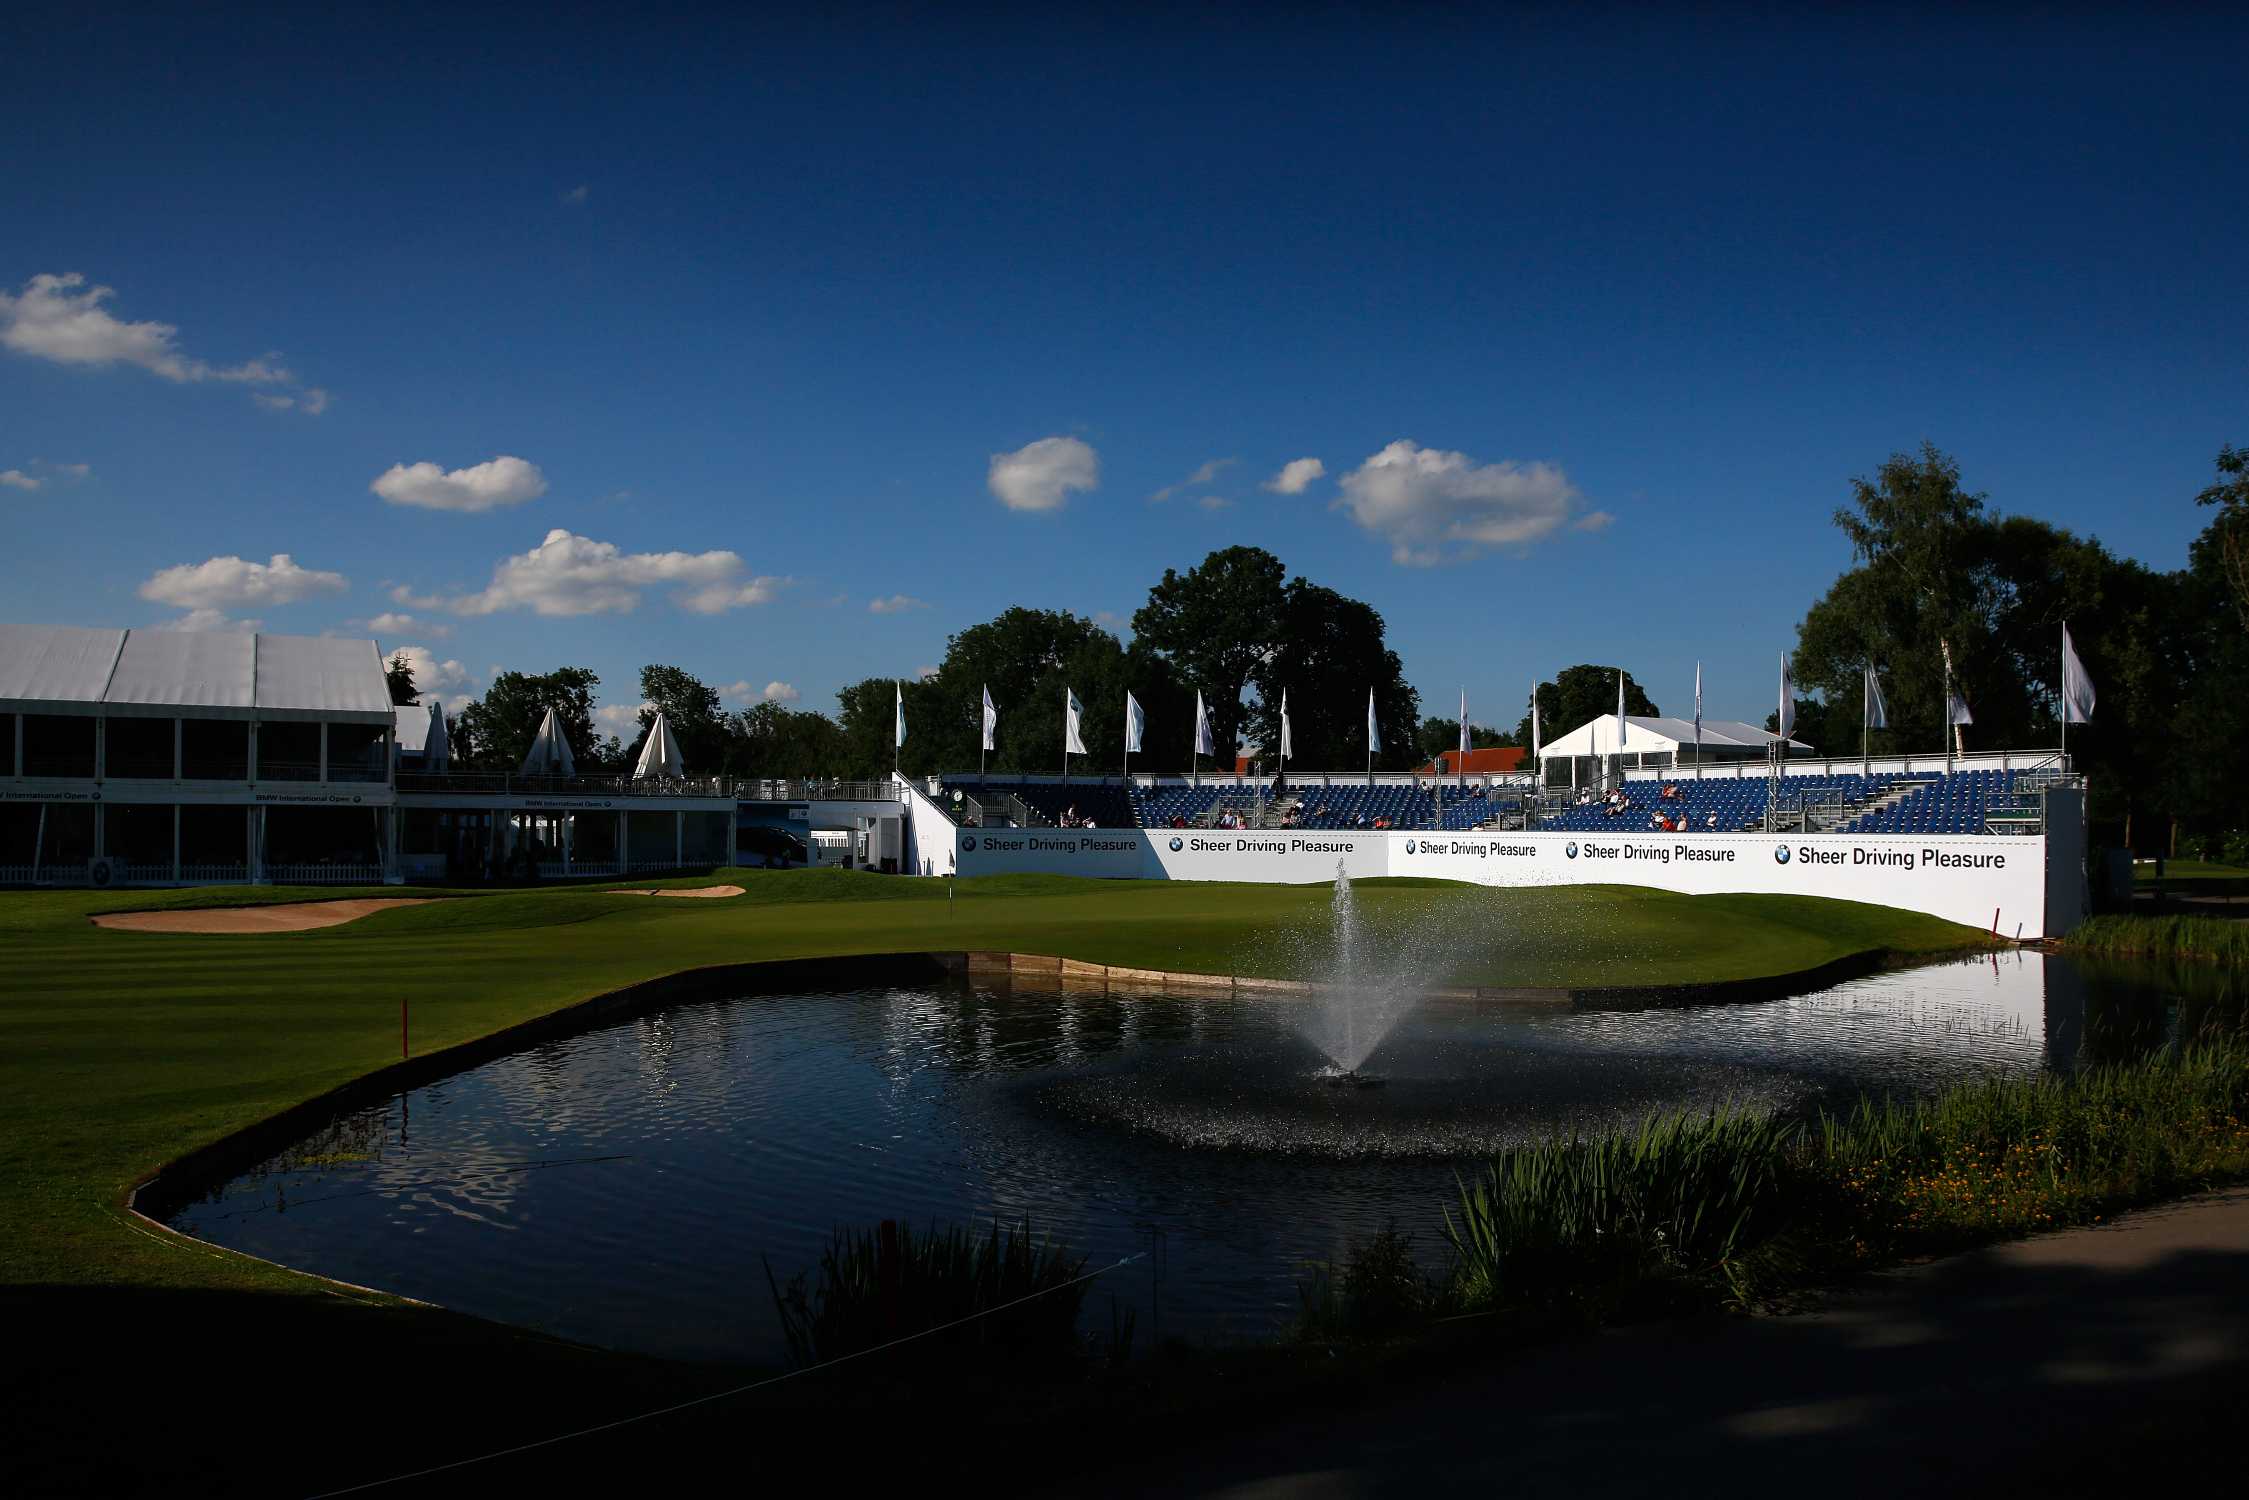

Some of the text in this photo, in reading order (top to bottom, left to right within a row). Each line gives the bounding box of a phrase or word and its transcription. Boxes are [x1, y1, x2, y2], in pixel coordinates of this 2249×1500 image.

[984, 837, 1136, 854] Sheer Driving Pleasure
[1190, 838, 1353, 855] Sheer Driving Pleasure
[1420, 841, 1536, 858] Sheer Driving Pleasure
[1584, 843, 1735, 864] Sheer Driving Pleasure
[1799, 846, 2005, 870] Sheer Driving Pleasure
